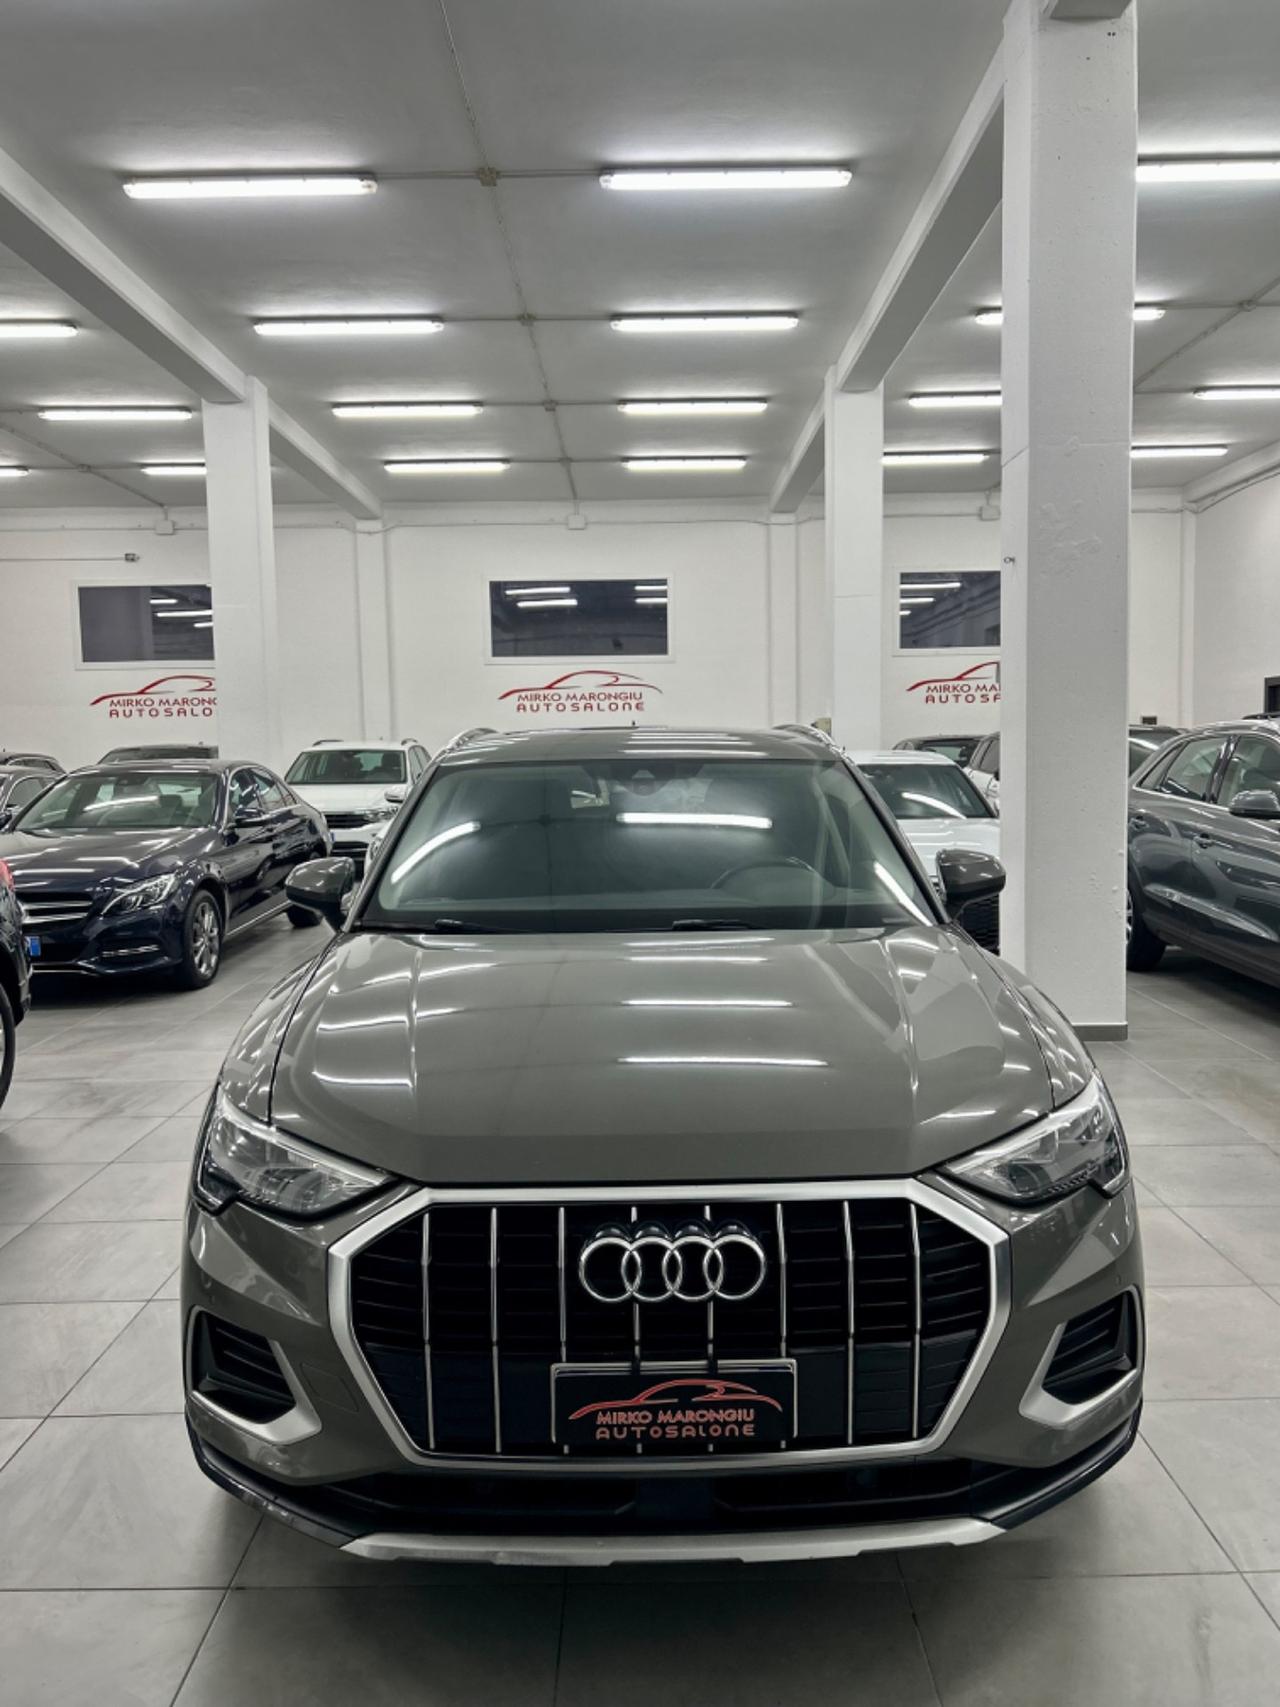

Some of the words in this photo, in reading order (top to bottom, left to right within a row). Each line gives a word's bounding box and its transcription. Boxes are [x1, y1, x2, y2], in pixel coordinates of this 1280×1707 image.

[926, 684, 971, 693] MIRKO
[975, 684, 1001, 693] MA
[517, 692, 562, 702] MIRKO
[565, 692, 643, 702] MARONGIU
[109, 698, 155, 707] MIRKO
[516, 702, 645, 712] AUTOSALONE
[596, 1410, 652, 1425] MIRKO
[657, 1408, 755, 1424] MARONGIU
[595, 1423, 755, 1440] AUTOSALONE
